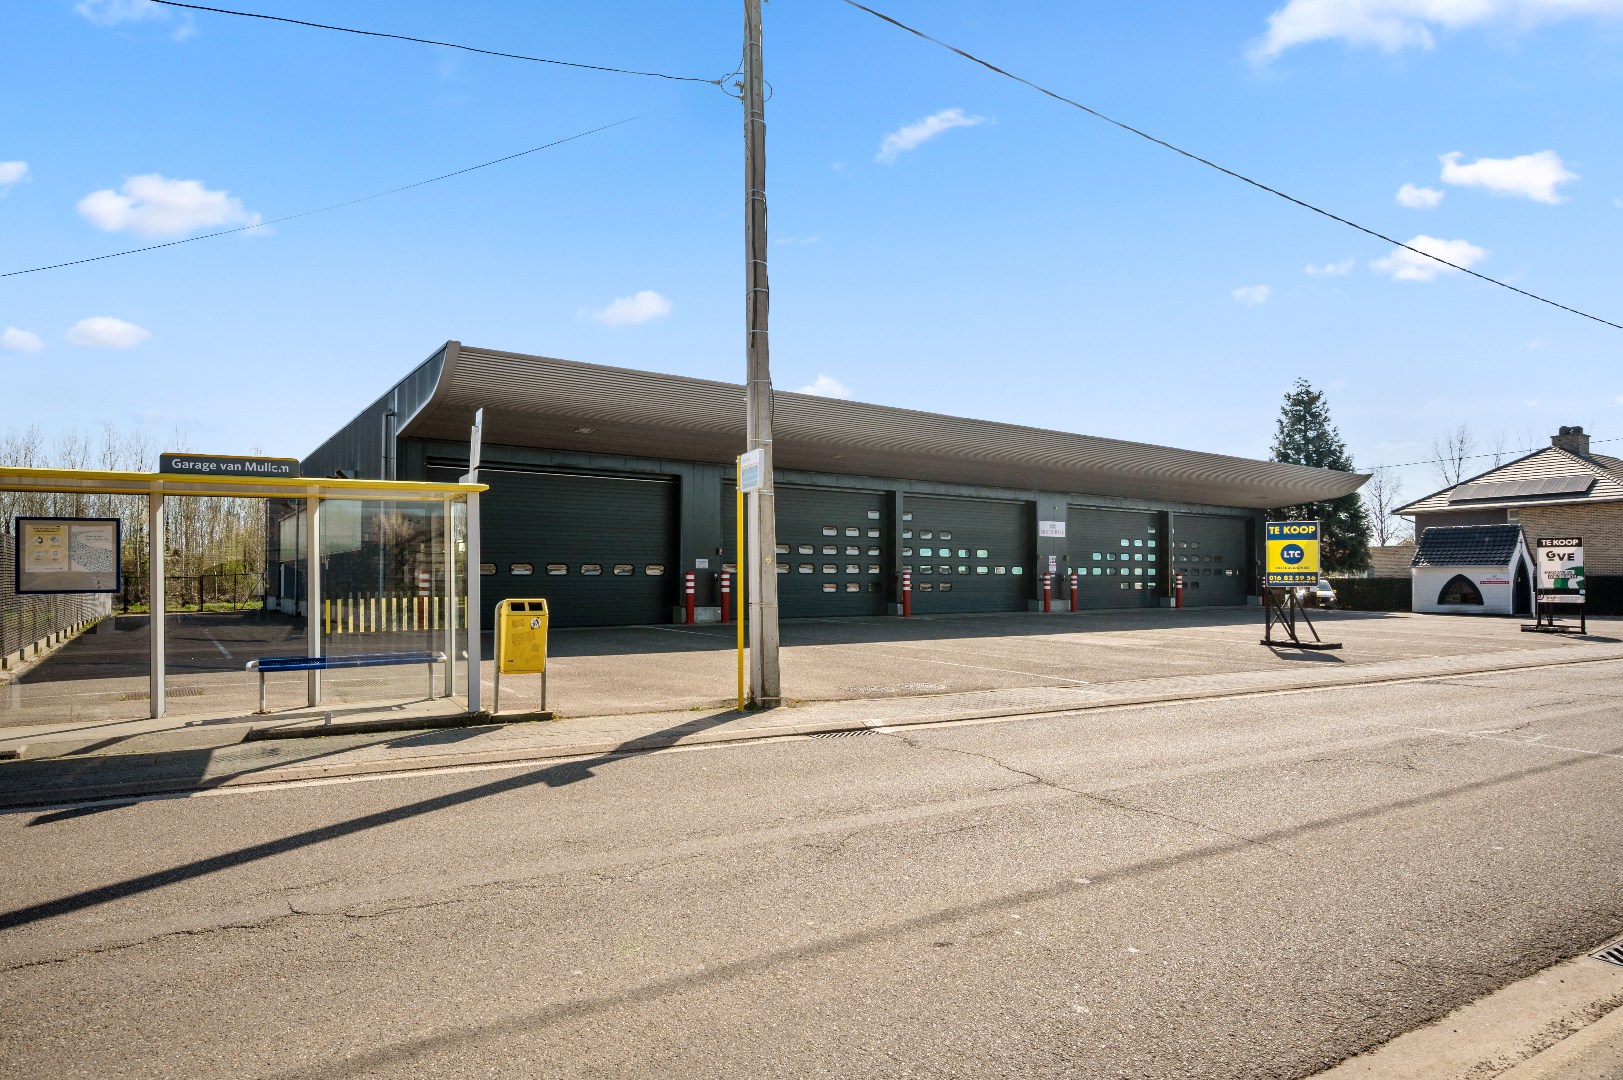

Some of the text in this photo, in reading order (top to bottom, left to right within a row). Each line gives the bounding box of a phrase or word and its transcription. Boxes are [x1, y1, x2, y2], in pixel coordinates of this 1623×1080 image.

[171, 459, 217, 471] Garage
[220, 463, 241, 471] van
[1268, 525, 1316, 534] TE KOOP
[1283, 550, 1301, 558] LTC
[1545, 551, 1575, 561] GVE
